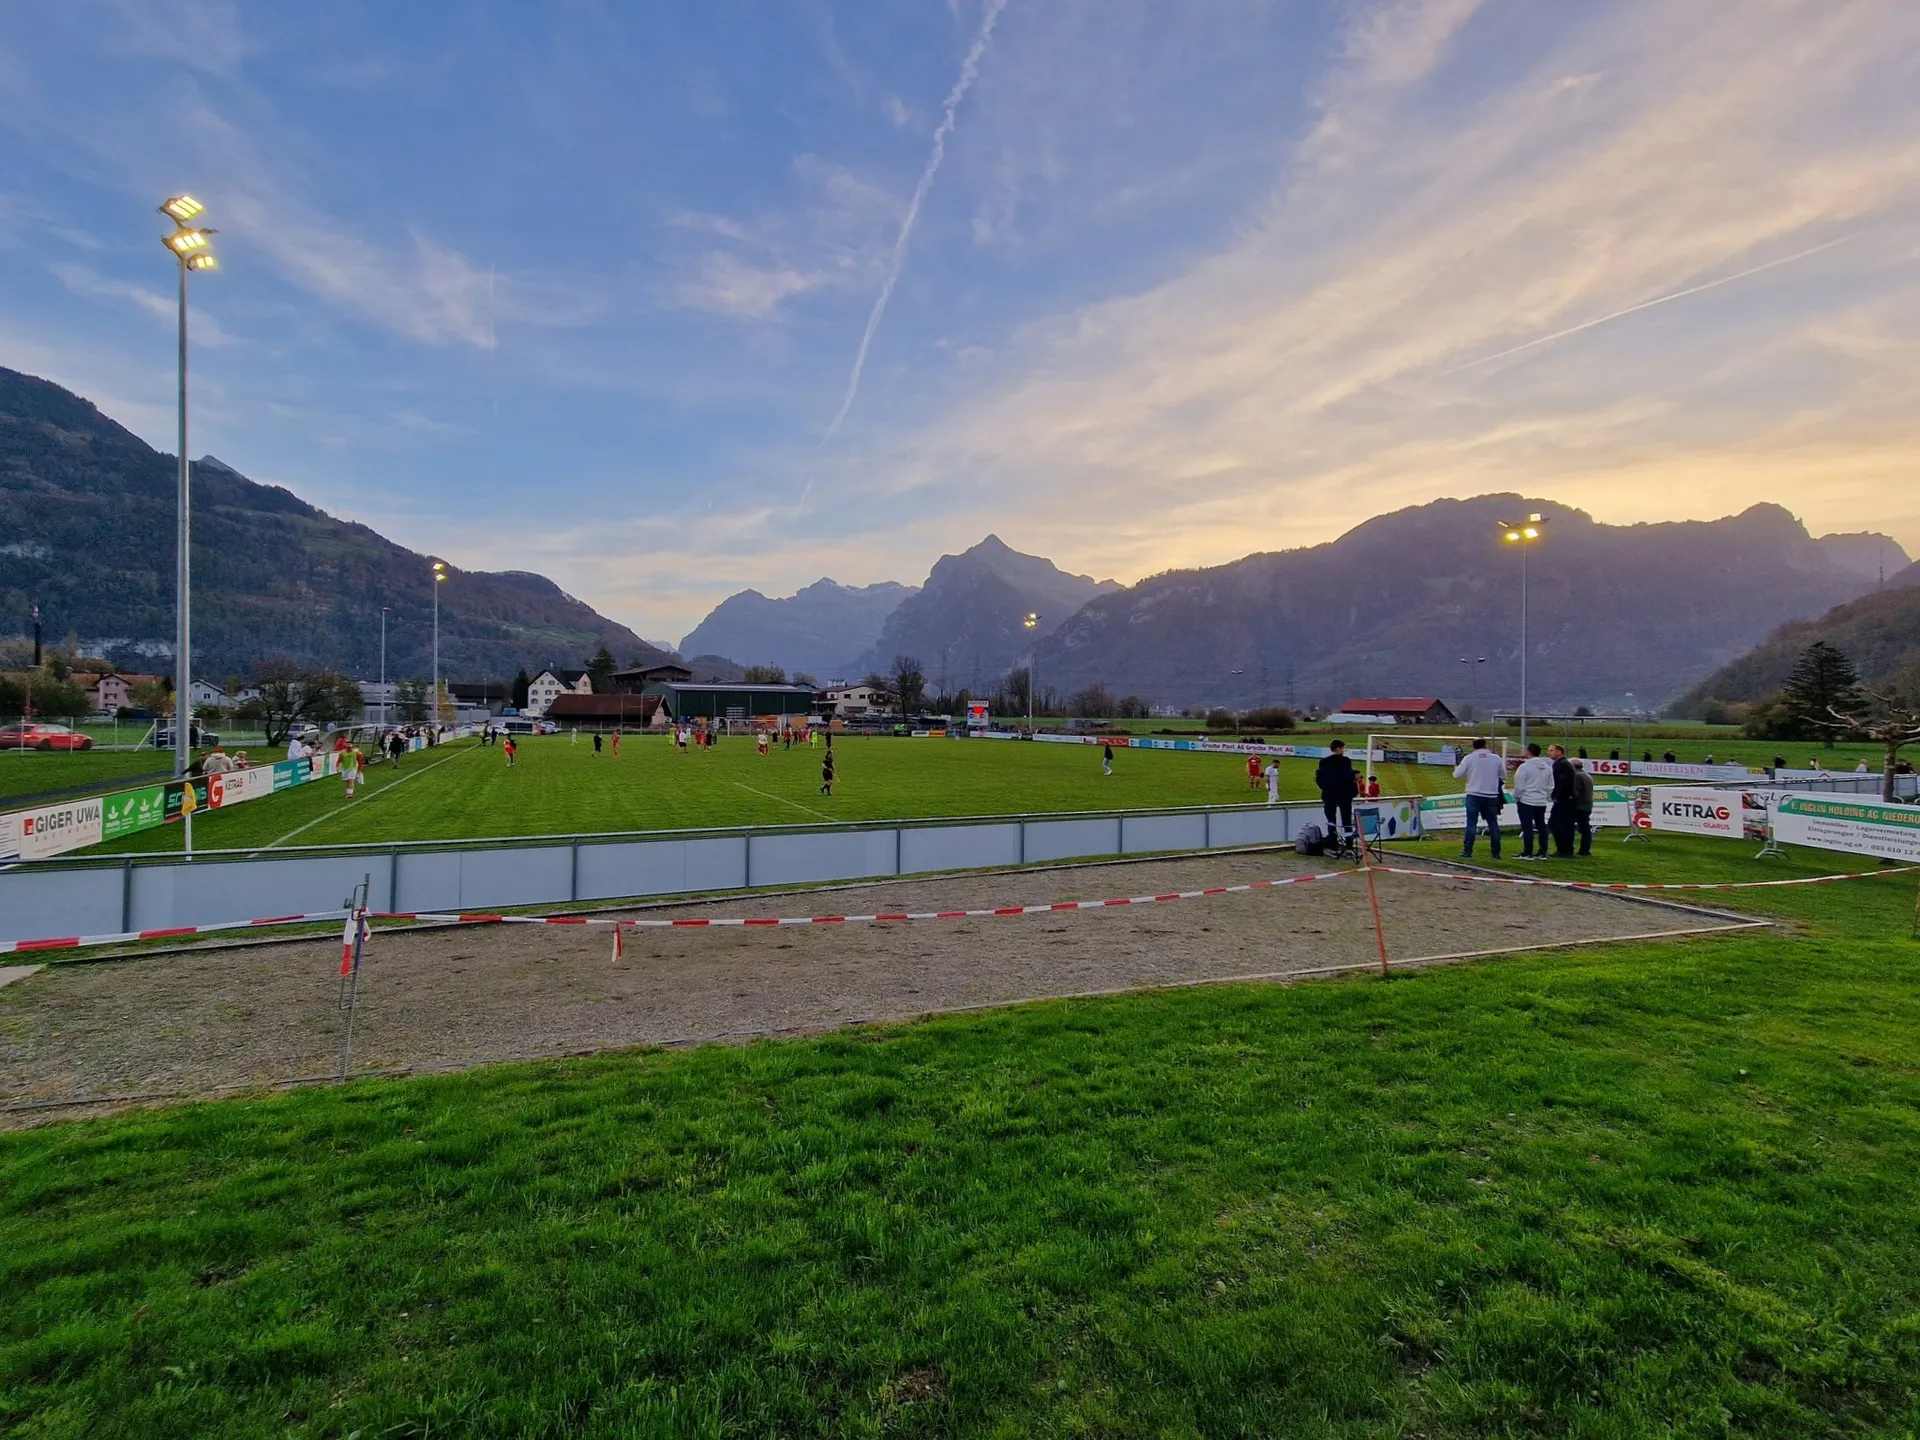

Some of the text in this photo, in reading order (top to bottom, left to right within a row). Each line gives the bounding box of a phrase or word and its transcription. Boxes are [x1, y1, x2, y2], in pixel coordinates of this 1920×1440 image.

[1592, 760, 1629, 774] 16:9
[1646, 763, 1704, 774] RAIFFEISEN
[1662, 802, 1731, 821] KETRAG
[1800, 803, 1826, 813] INGLIN
[1828, 805, 1864, 818] HOLDING
[1867, 809, 1879, 820] AG
[36, 810, 73, 833] GIGER
[76, 805, 100, 824] UWA
[1703, 822, 1730, 830] GLARUS
[1856, 824, 1917, 838] Lagervermietung
[1862, 833, 1920, 846] Dienstleistunge
